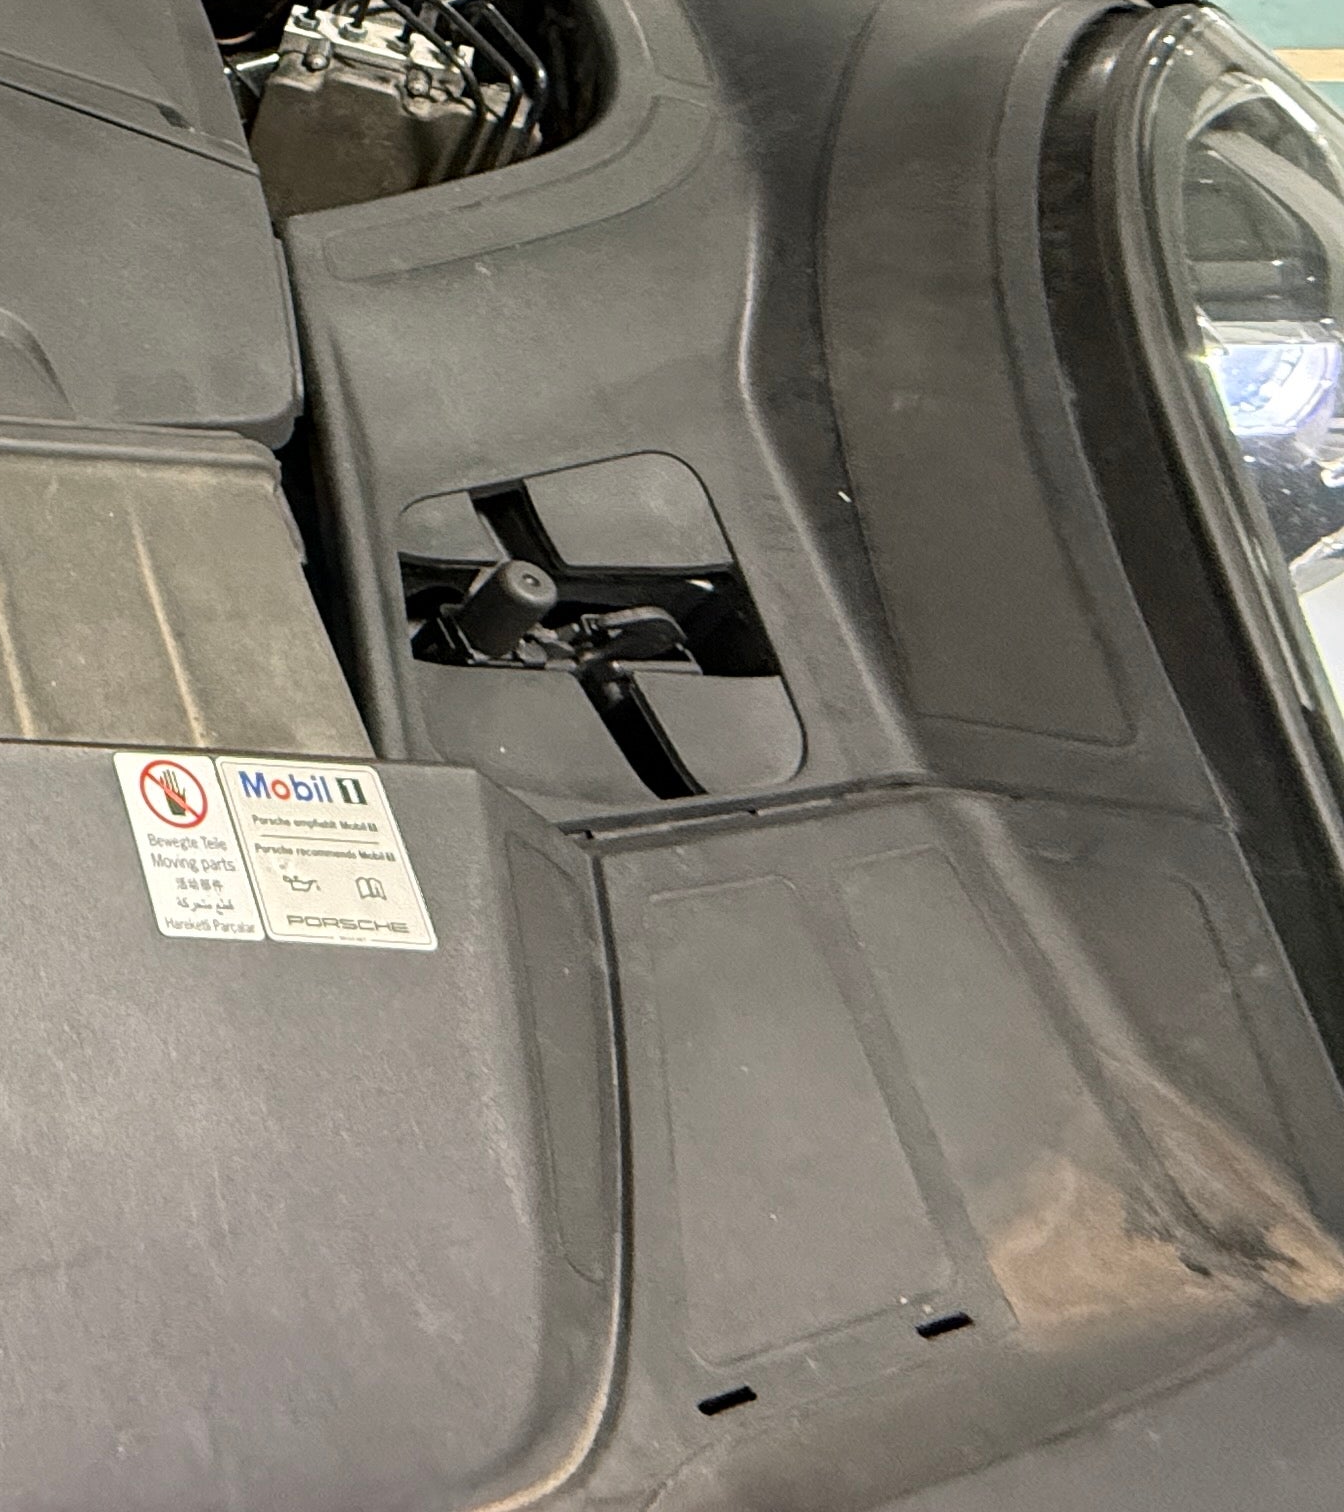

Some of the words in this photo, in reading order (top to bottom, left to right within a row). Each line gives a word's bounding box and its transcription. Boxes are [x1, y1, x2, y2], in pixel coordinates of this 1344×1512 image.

[238, 771, 334, 803] Mobil
[147, 833, 199, 851] Bewegte
[150, 852, 200, 873] Moving
[201, 857, 236, 873] parts
[286, 915, 410, 933] PORSCHE
